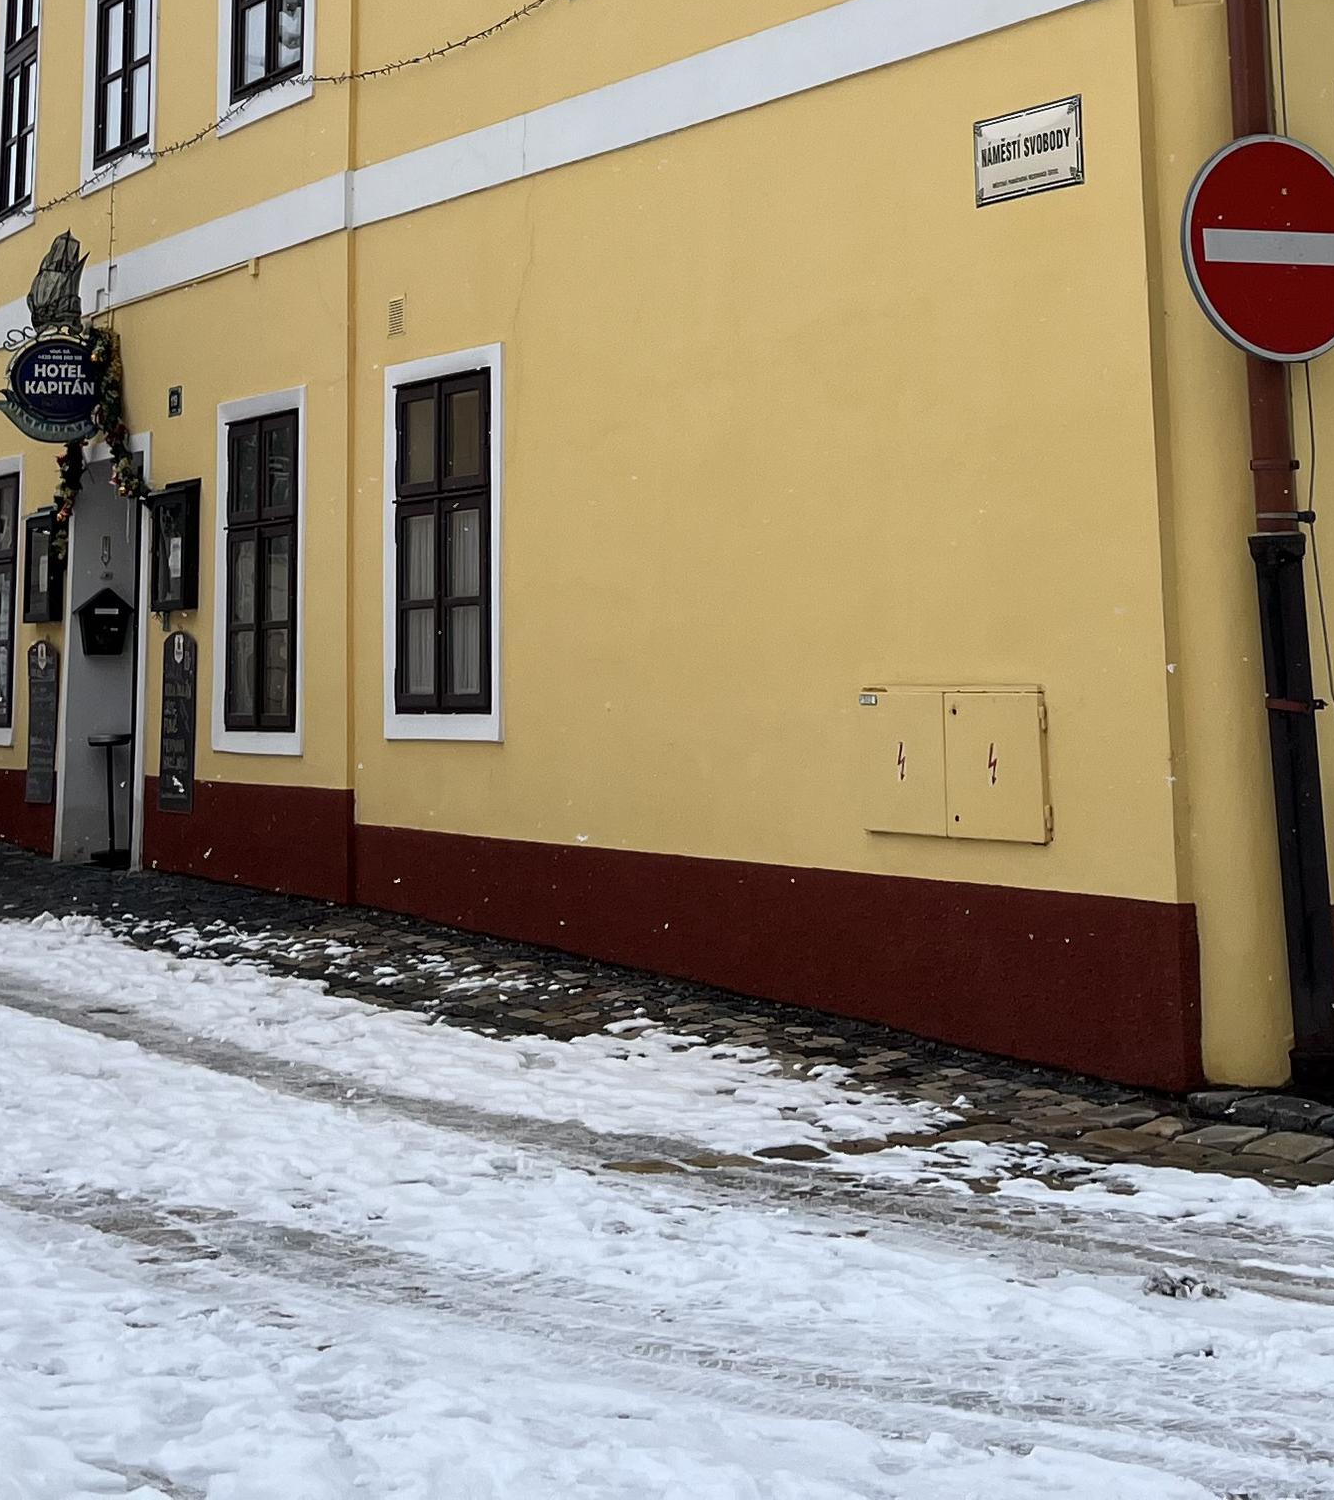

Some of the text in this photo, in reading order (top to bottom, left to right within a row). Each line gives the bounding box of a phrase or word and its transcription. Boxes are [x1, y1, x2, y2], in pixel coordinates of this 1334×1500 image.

[981, 127, 1071, 168] NÁMĚSTÍ SVOBODY
[34, 363, 86, 378] HOTEL
[24, 379, 95, 395] KAPITÁN
